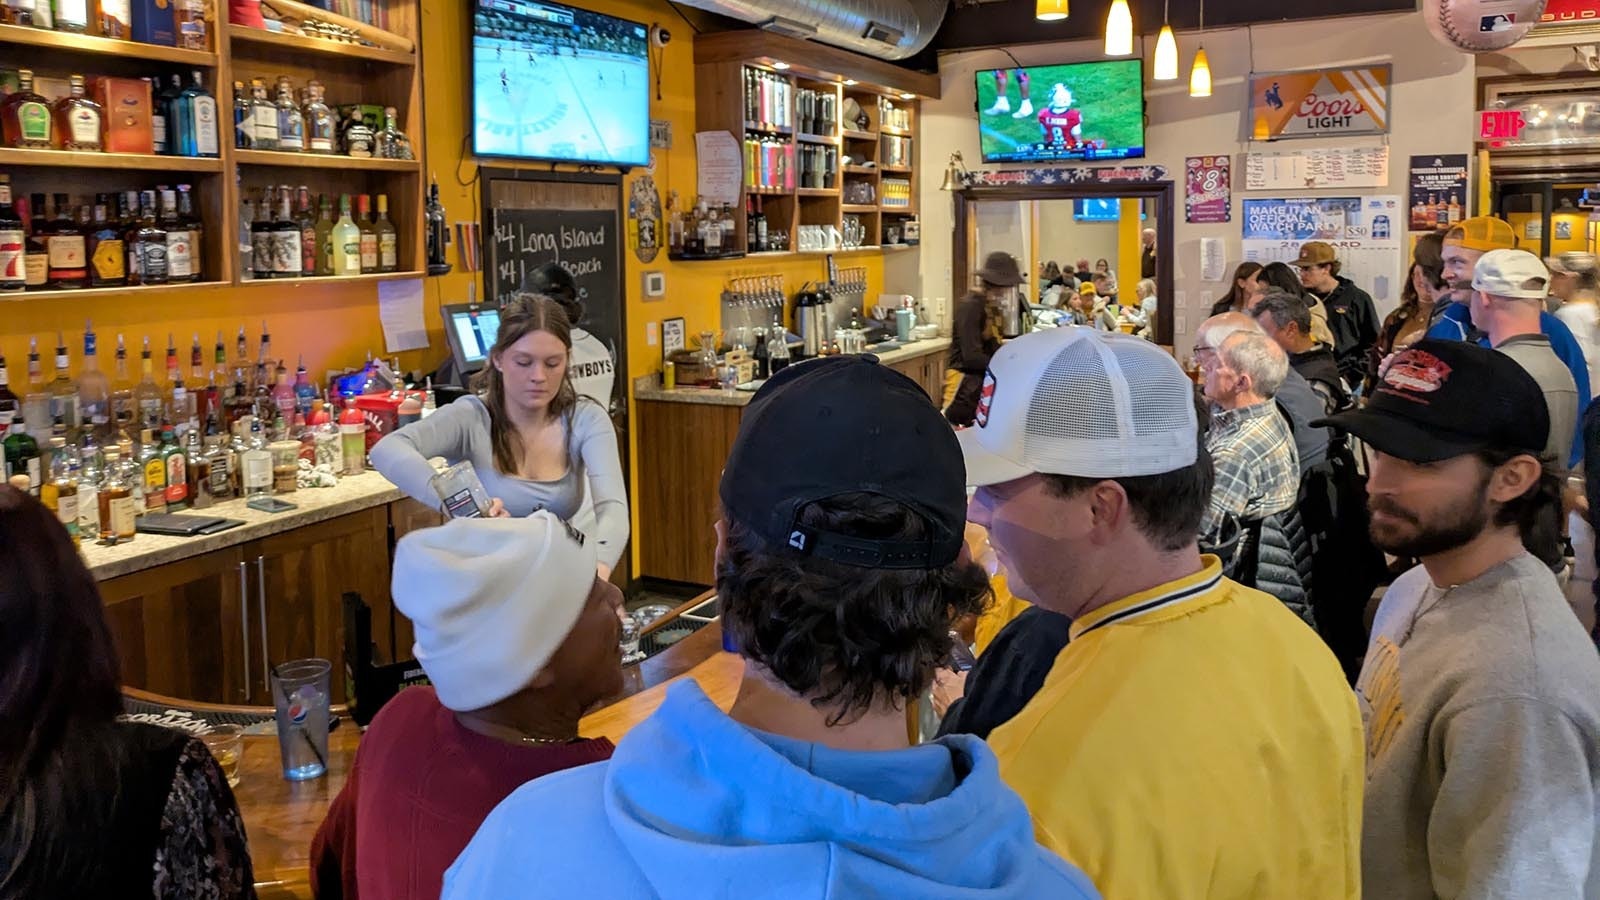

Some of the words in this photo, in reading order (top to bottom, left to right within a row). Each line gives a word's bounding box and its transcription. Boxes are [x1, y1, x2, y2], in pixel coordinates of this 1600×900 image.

[1295, 93, 1368, 117] Coors
[1307, 115, 1353, 129] LIGHT
[1481, 111, 1521, 138] EXIT
[1250, 205, 1286, 216] MAKE
[1289, 205, 1301, 215] IT
[1303, 204, 1322, 214] AN
[1250, 214, 1307, 224] OFFICIAL
[1250, 222, 1294, 232] WATCH
[1297, 222, 1338, 232] PARTY
[520, 222, 559, 265] Long
[560, 224, 604, 250] Island
[560, 256, 602, 278] Beach
[568, 360, 612, 379] OWBOYS
